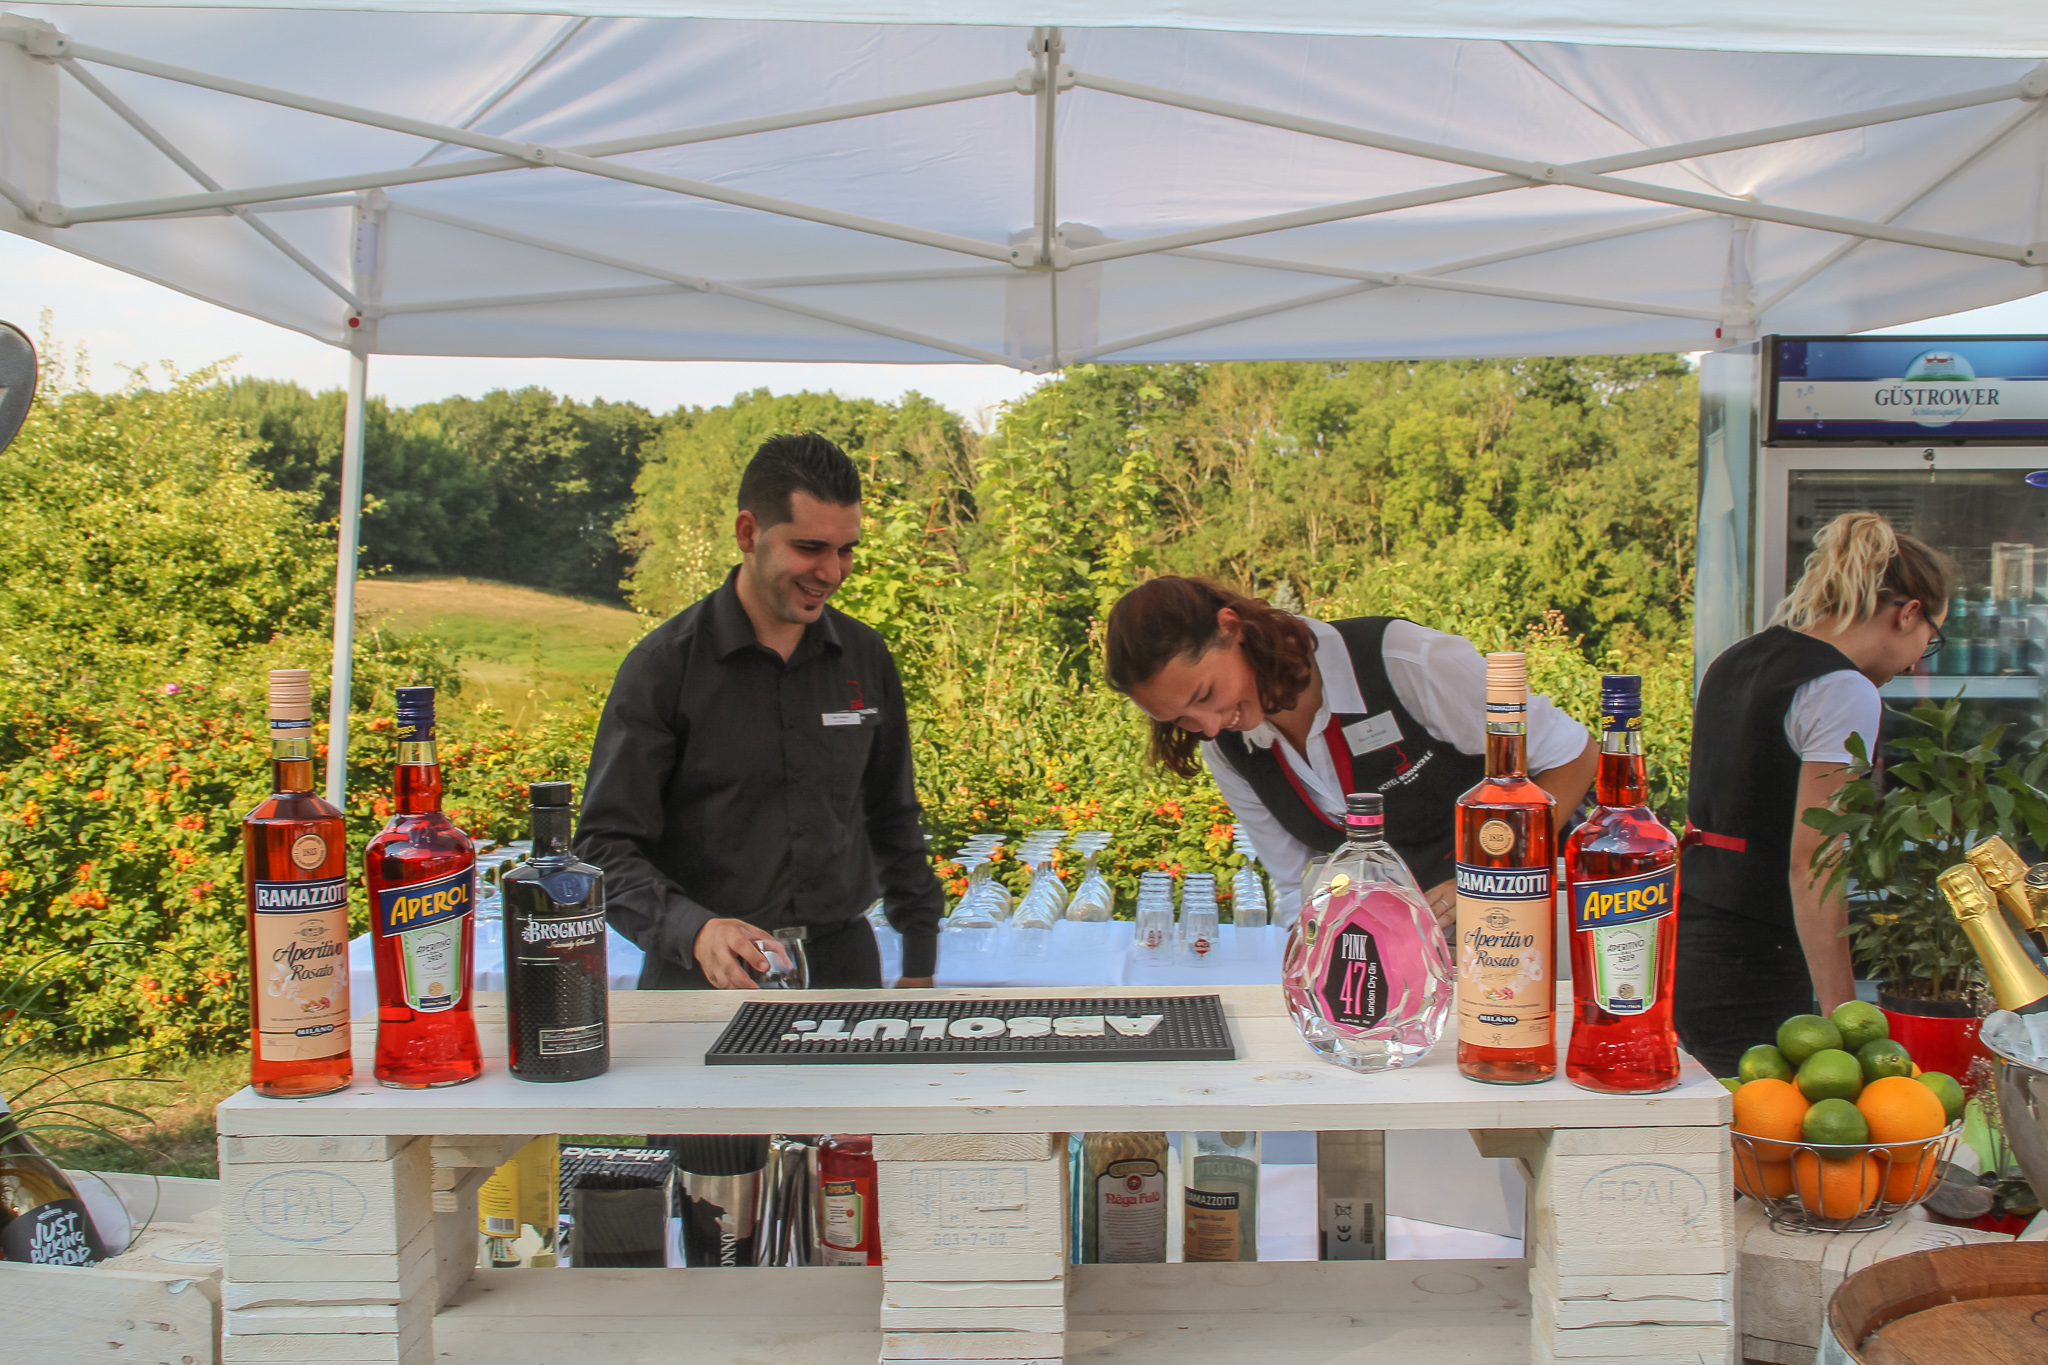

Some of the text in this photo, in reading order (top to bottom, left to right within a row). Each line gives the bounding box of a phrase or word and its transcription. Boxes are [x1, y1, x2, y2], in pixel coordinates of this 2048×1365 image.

[1875, 386, 2000, 406] GÜSTROWER
[1377, 778, 1400, 792] HOTEL
[1456, 870, 1547, 894] RAMAZZOTTI
[390, 883, 469, 926] APEROL
[1583, 883, 1668, 921] APEROL
[1341, 933, 1368, 960] PINK
[1464, 927, 1534, 951] Aperitivo
[272, 940, 343, 967] Aperitivo
[1475, 950, 1520, 968] Rosato
[290, 963, 334, 982] Rosato
[1367, 975, 1378, 989] Dry
[1339, 961, 1367, 1016] 47
[1366, 990, 1376, 1016] London
[297, 1025, 334, 1036] MILANO
[1479, 1014, 1518, 1023] MILANO
[30, 1211, 79, 1249] JUST
